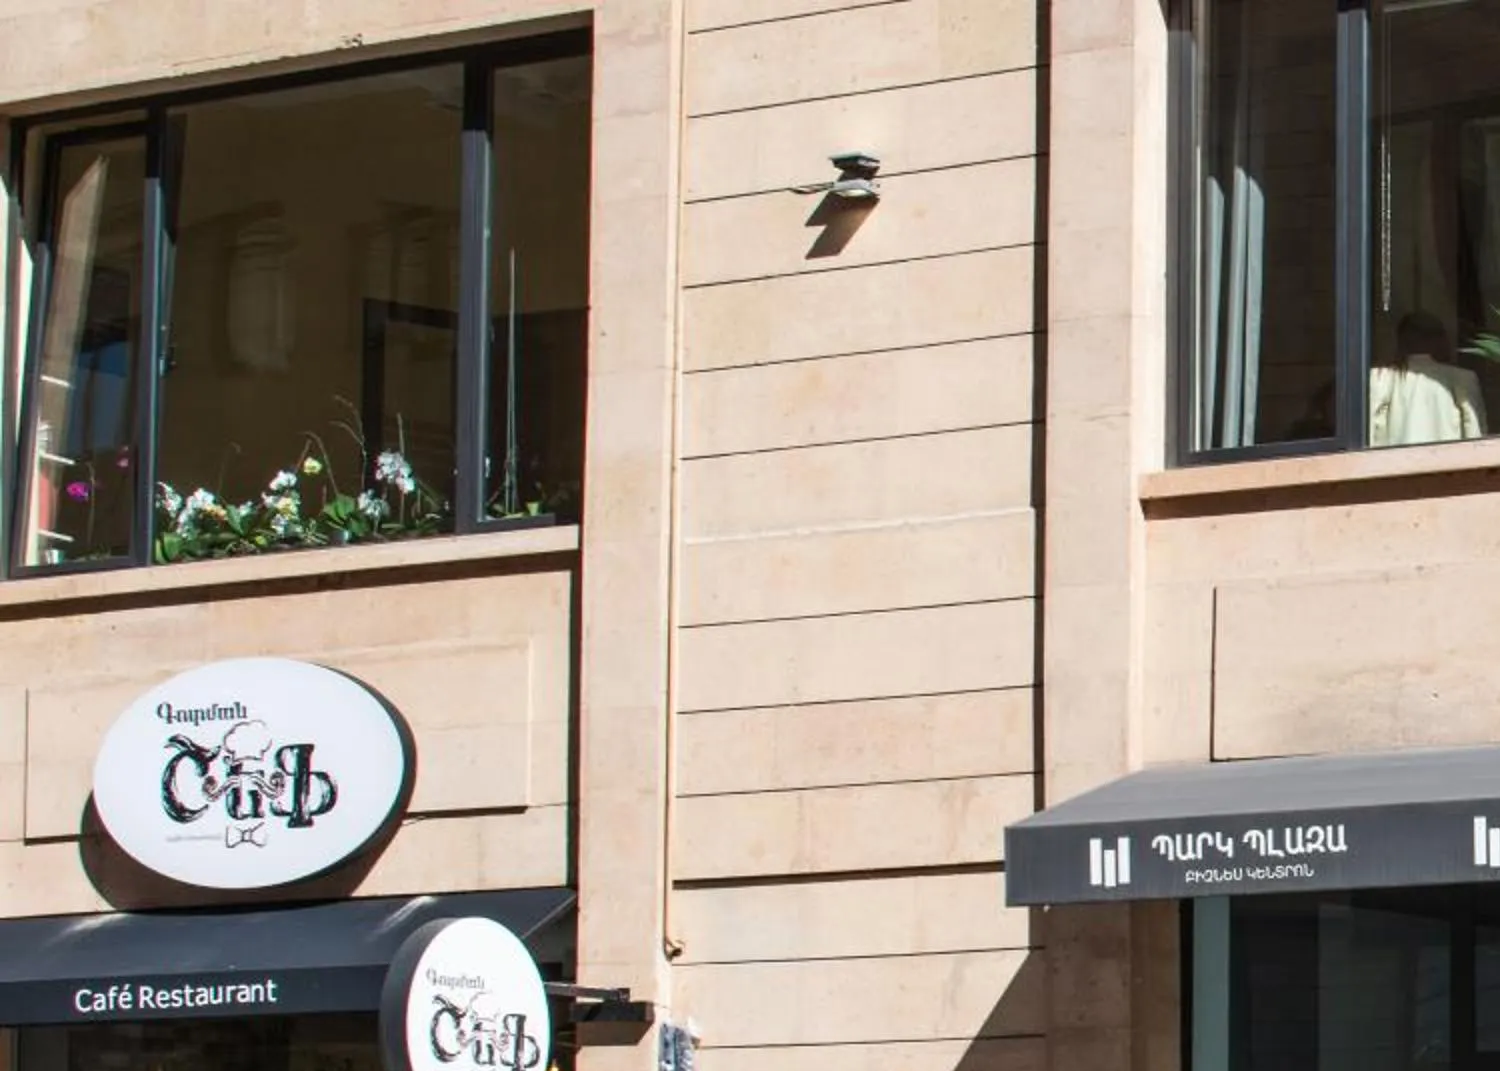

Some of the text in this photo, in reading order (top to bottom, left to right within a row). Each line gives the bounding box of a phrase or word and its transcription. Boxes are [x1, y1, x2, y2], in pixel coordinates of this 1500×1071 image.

[1151, 823, 1349, 861] ՊԱՐԿ ՊԼԱԶԱ
[1185, 863, 1315, 884] ԲԻԶՆԵՍ ԿԵՆՏՐՈՆ
[75, 979, 278, 1013] Café Restaurant
